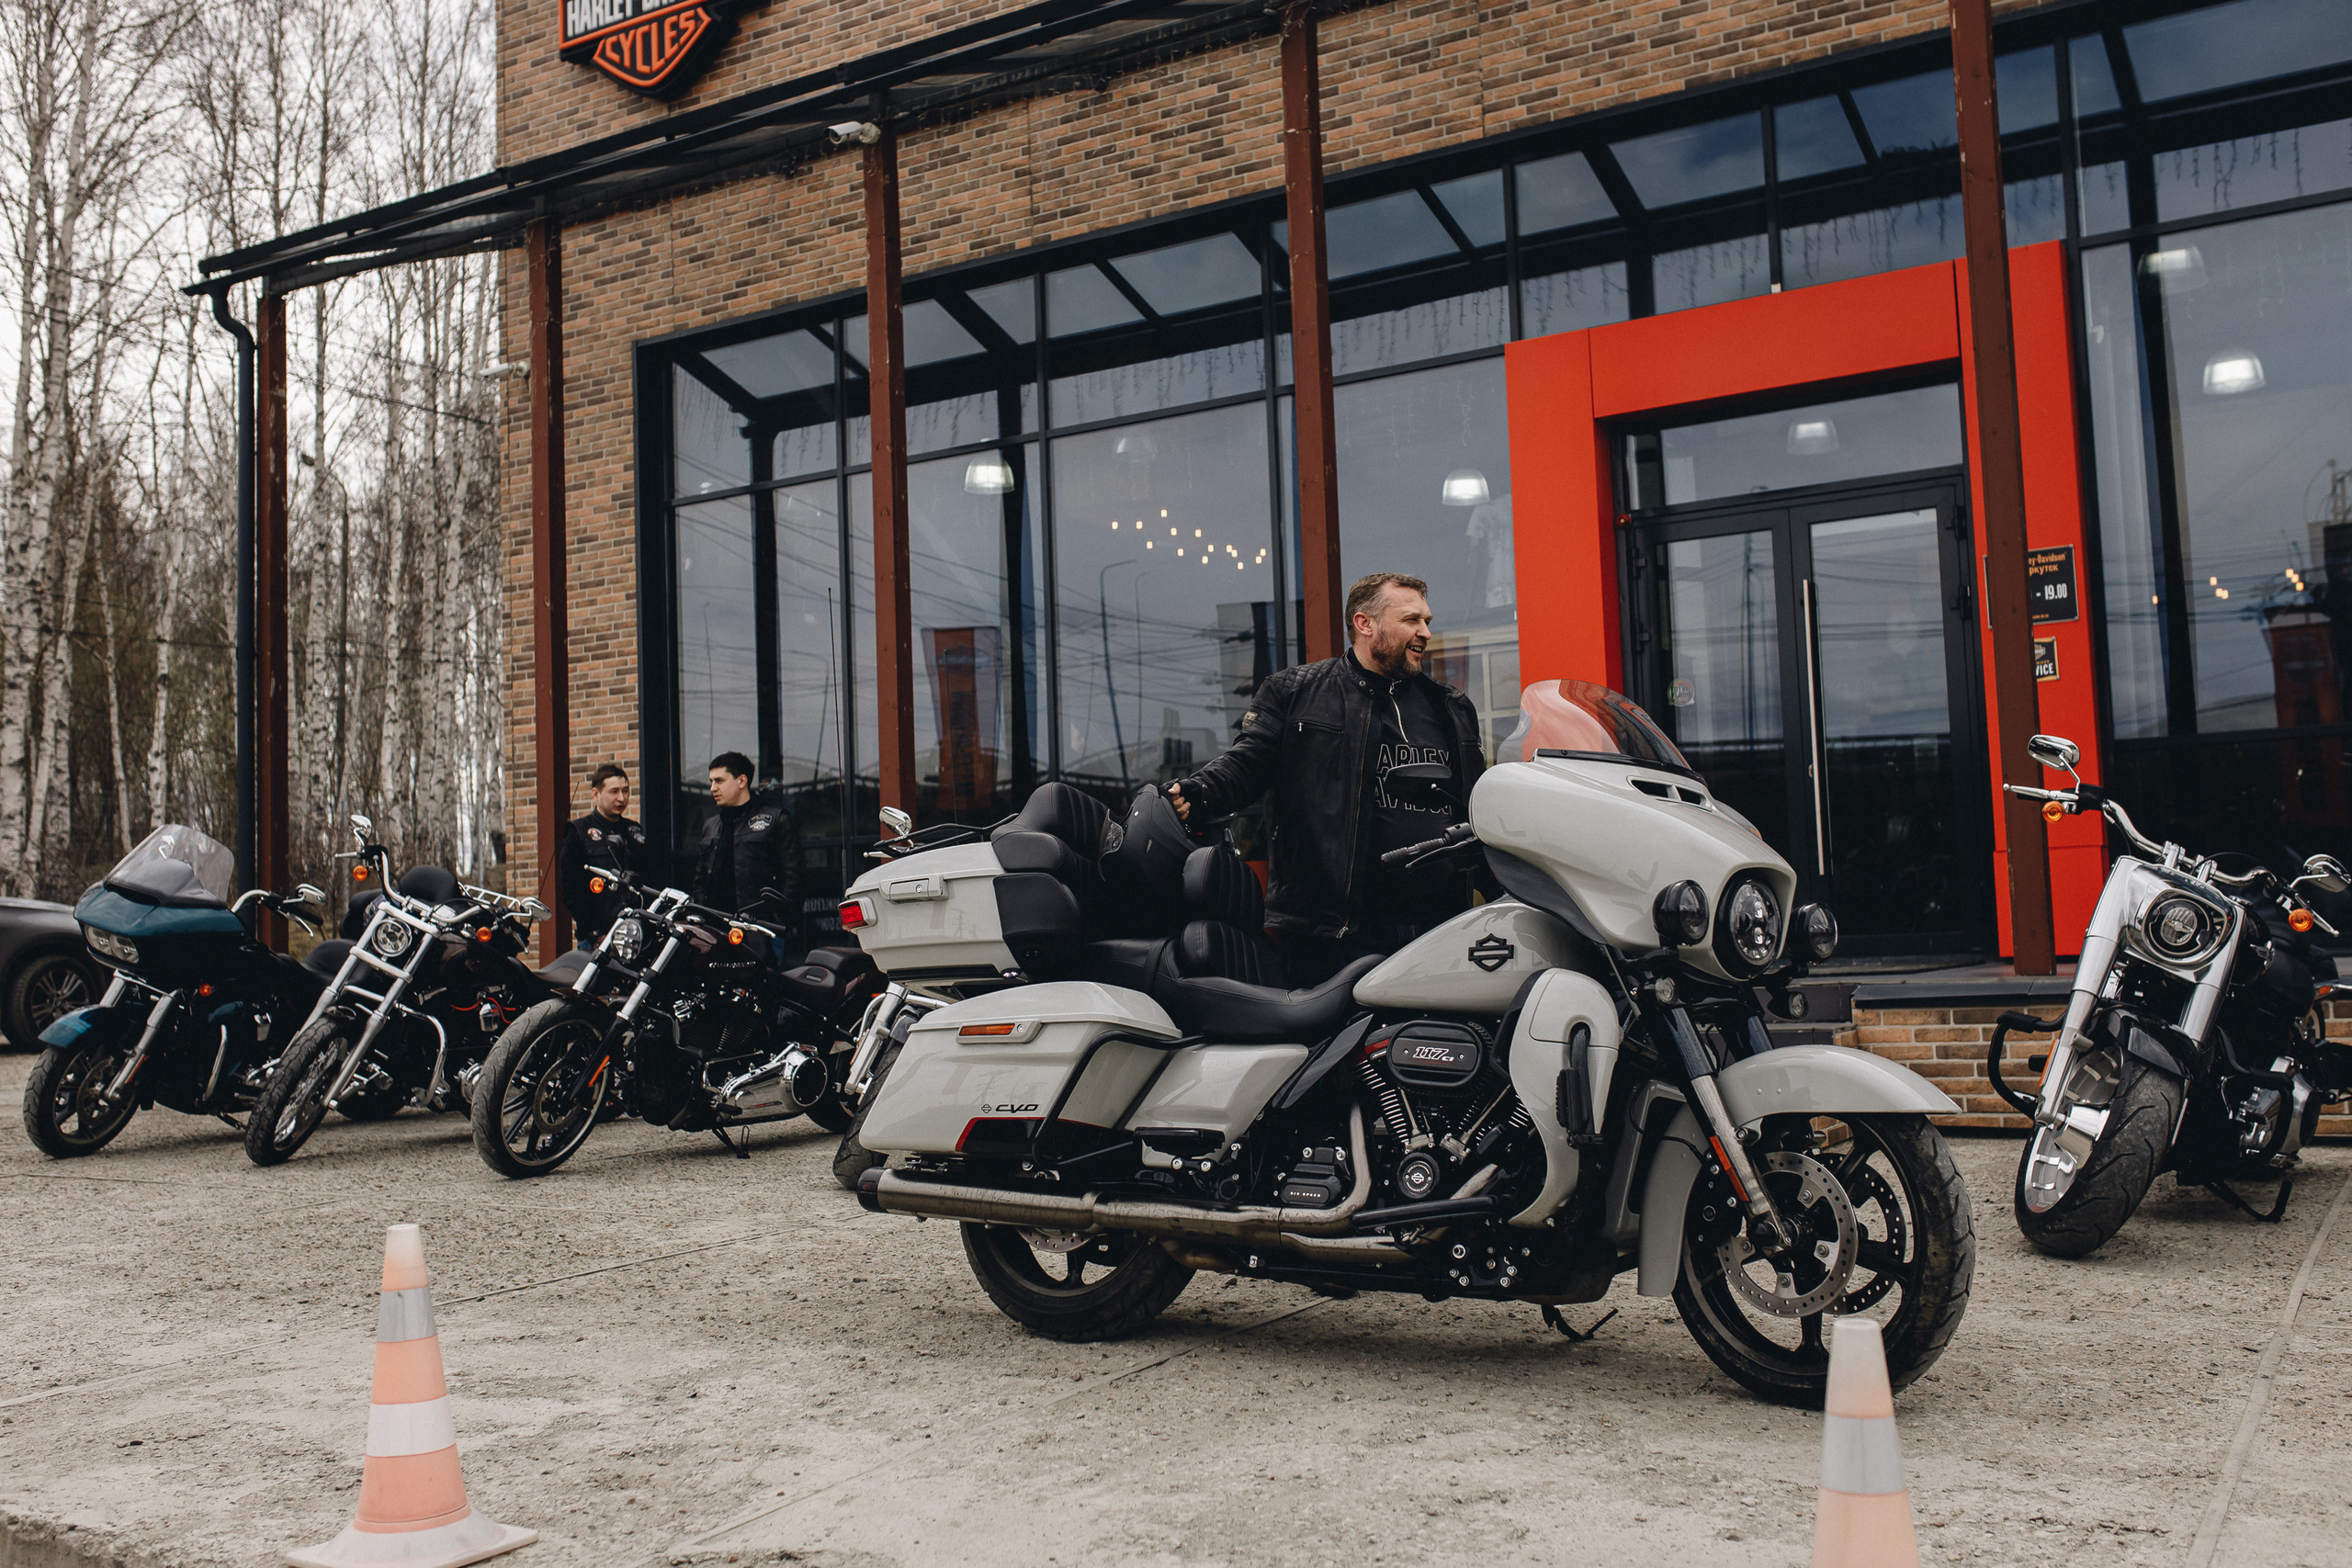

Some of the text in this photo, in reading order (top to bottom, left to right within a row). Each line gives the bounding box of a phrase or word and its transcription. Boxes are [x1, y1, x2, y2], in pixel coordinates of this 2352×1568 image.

[605, 9, 696, 74] CYCLES
[2029, 553, 2065, 567] ey-Davidson
[2029, 564, 2059, 577] ркутск
[2044, 583, 2068, 601] 19.00
[995, 1104, 1039, 1113] CVO
